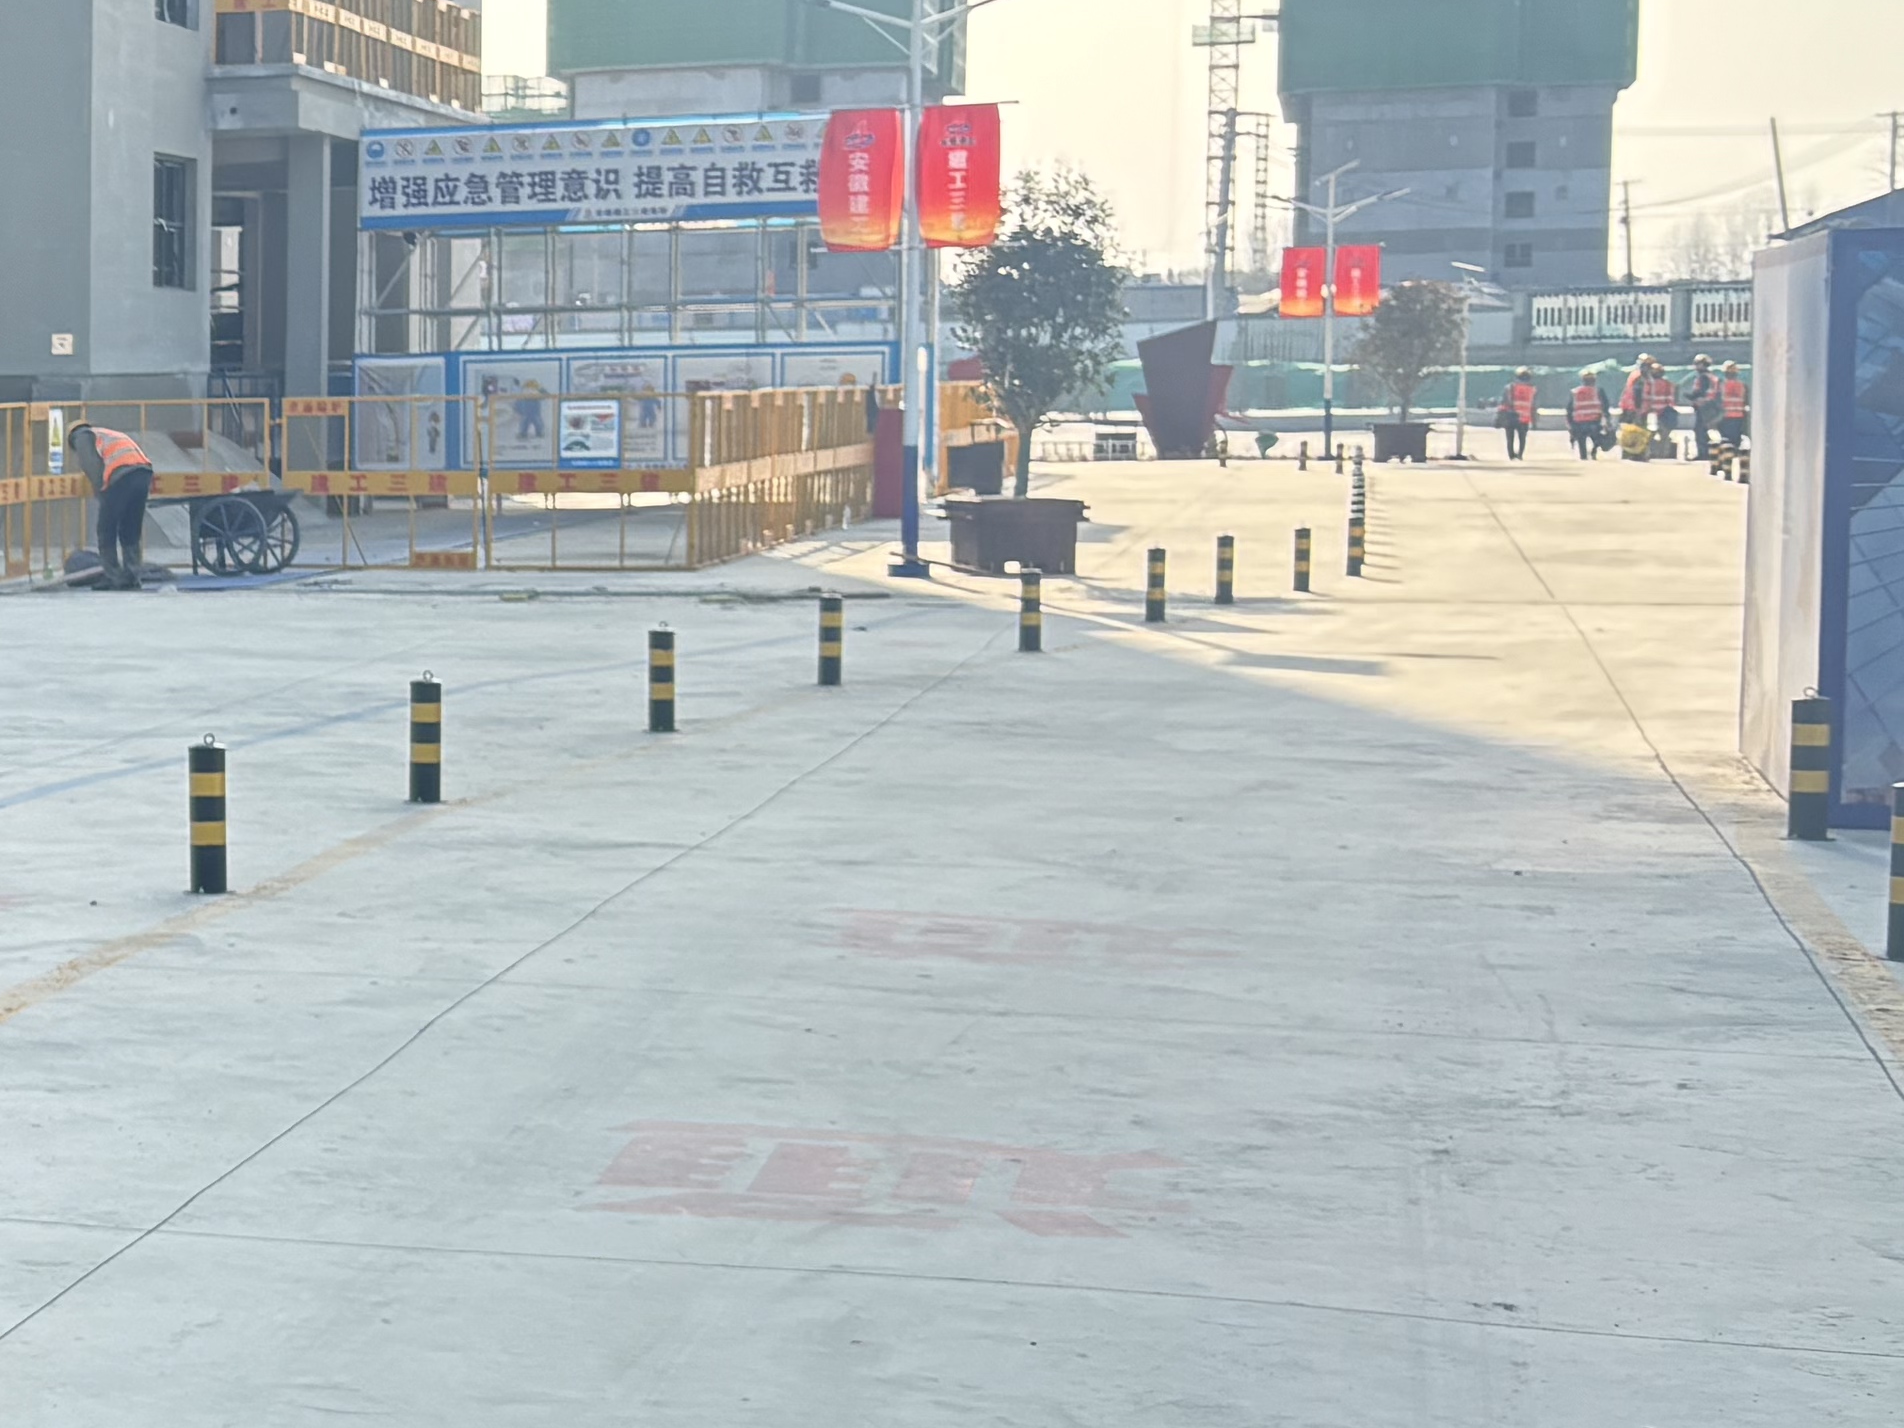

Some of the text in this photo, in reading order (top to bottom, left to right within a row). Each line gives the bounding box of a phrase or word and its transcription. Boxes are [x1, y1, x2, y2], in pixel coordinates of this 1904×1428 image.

[368, 168, 622, 211] 增强应急管理意识
